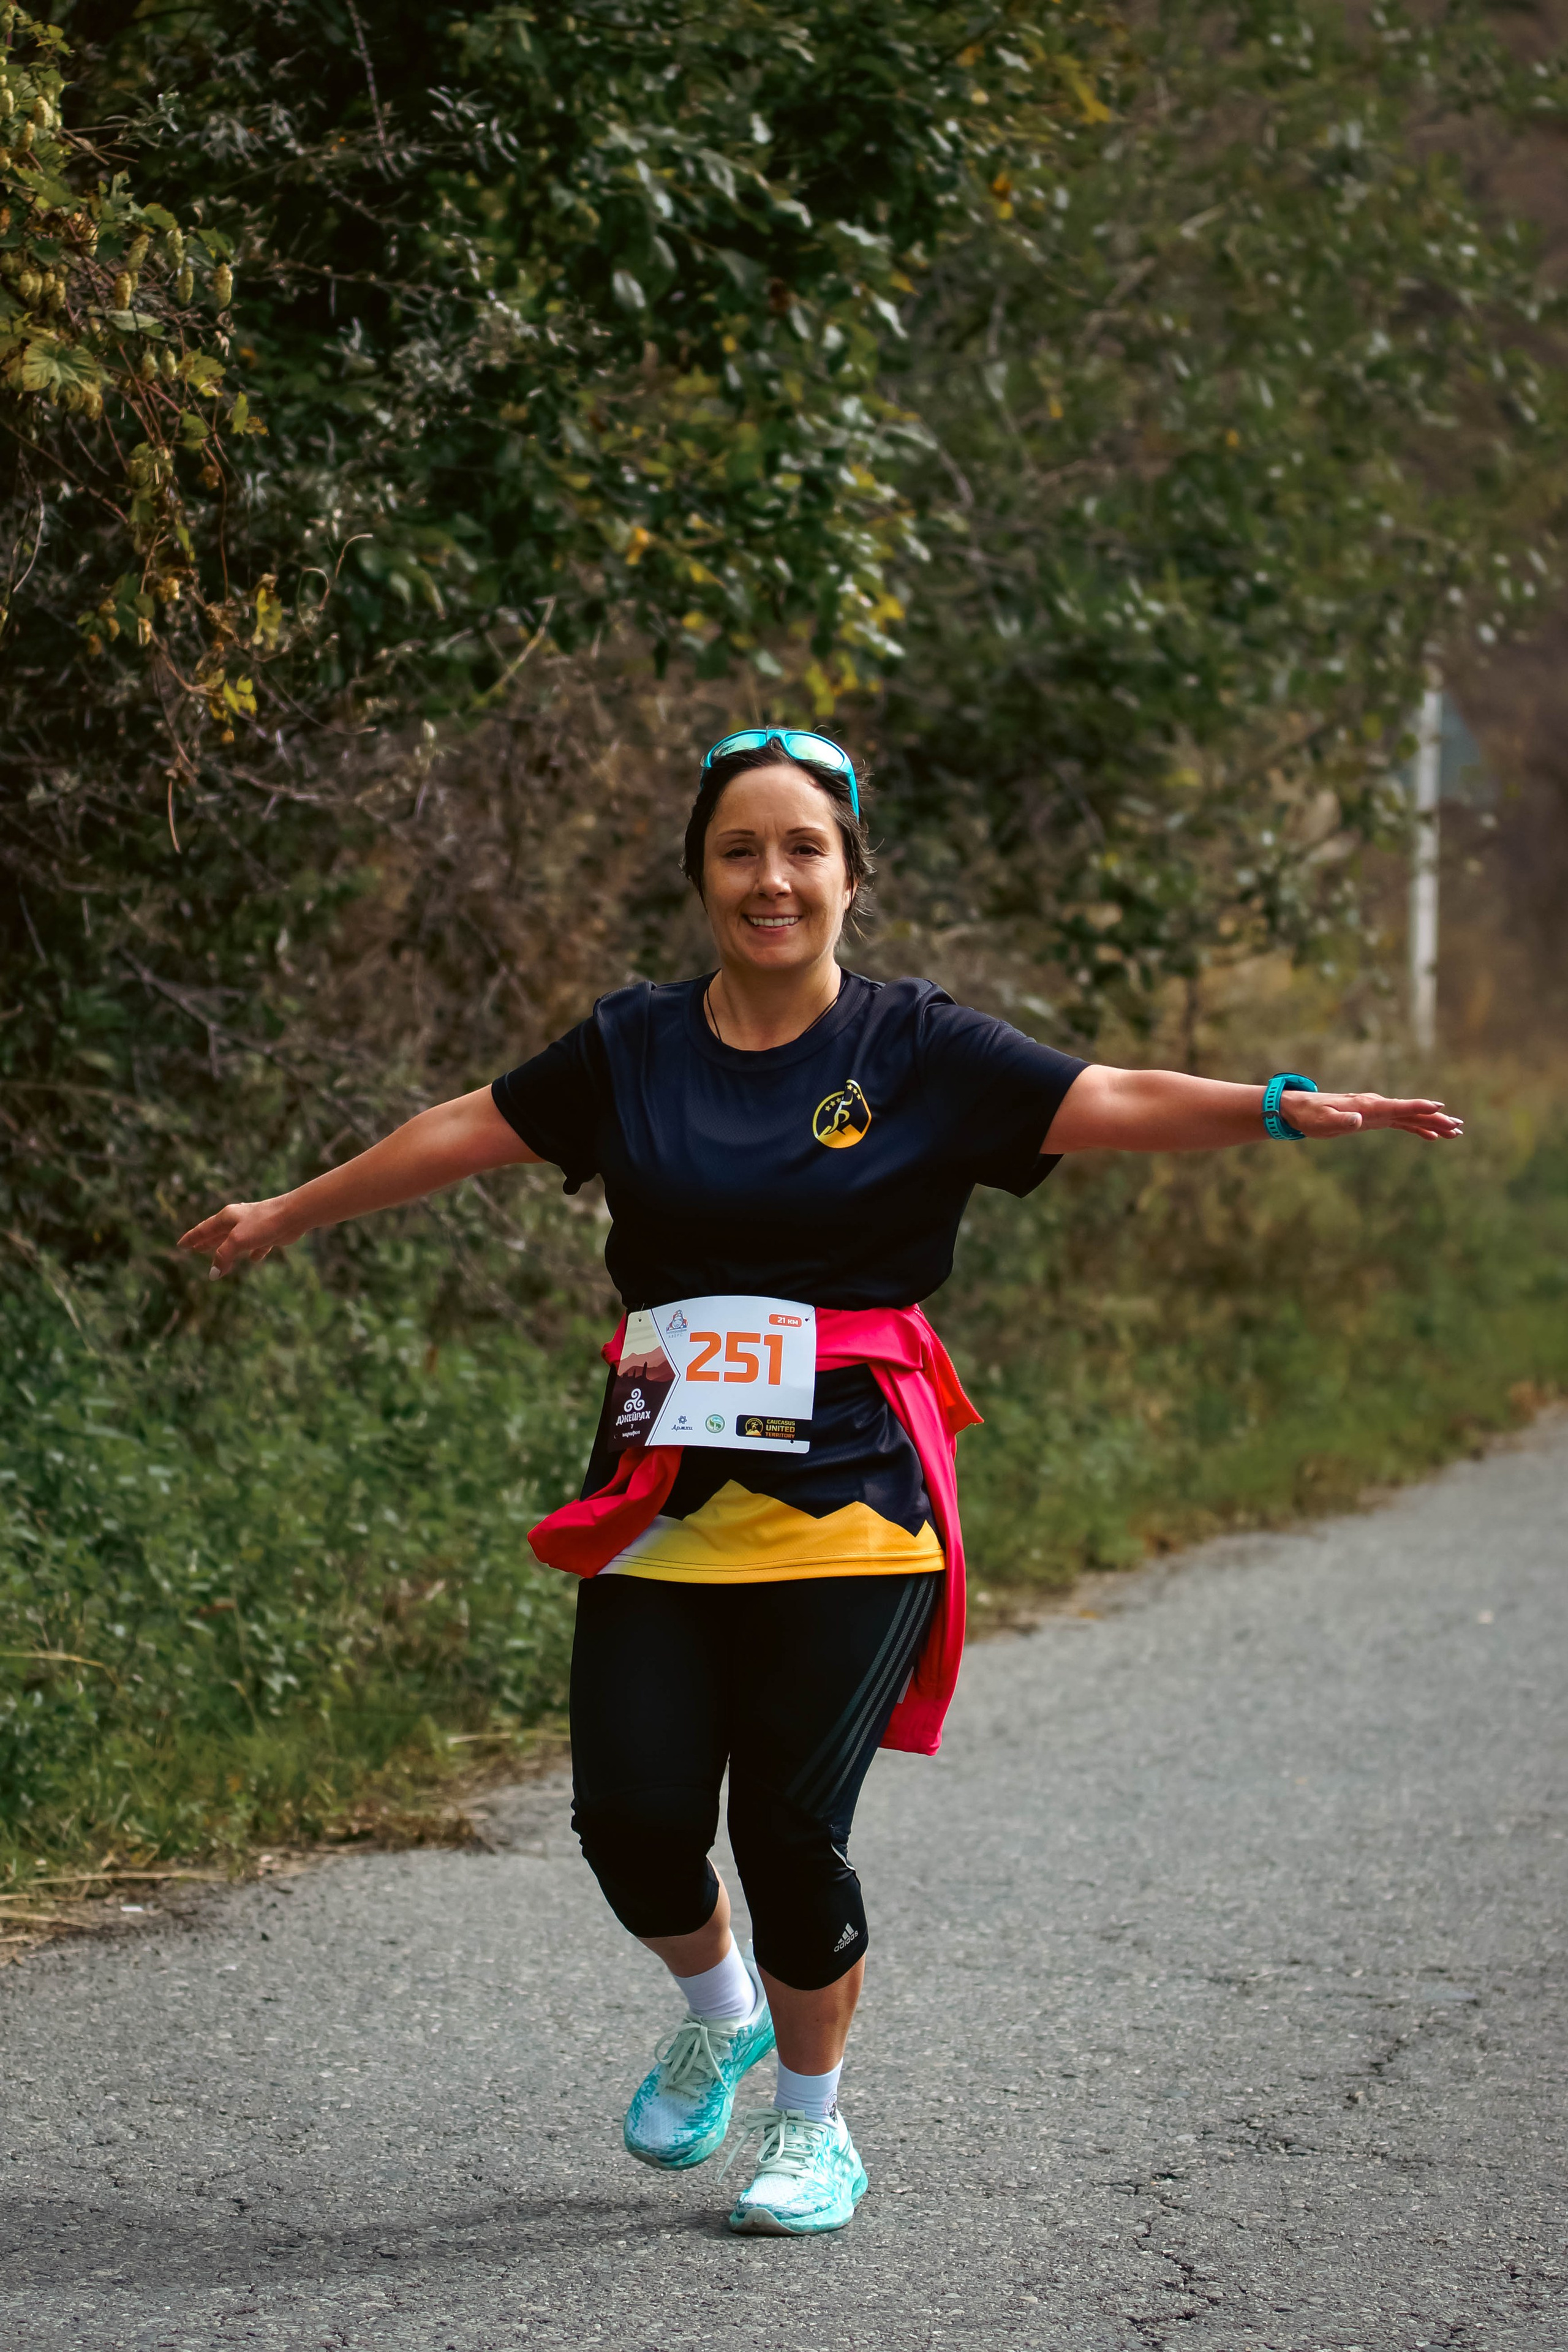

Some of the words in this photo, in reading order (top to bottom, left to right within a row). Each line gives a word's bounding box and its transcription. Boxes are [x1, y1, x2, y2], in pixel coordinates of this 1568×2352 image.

[685, 1331, 783, 1385] 251
[616, 1411, 651, 1426] ДЖЕЙРАХ
[834, 1930, 859, 1953] adidas
